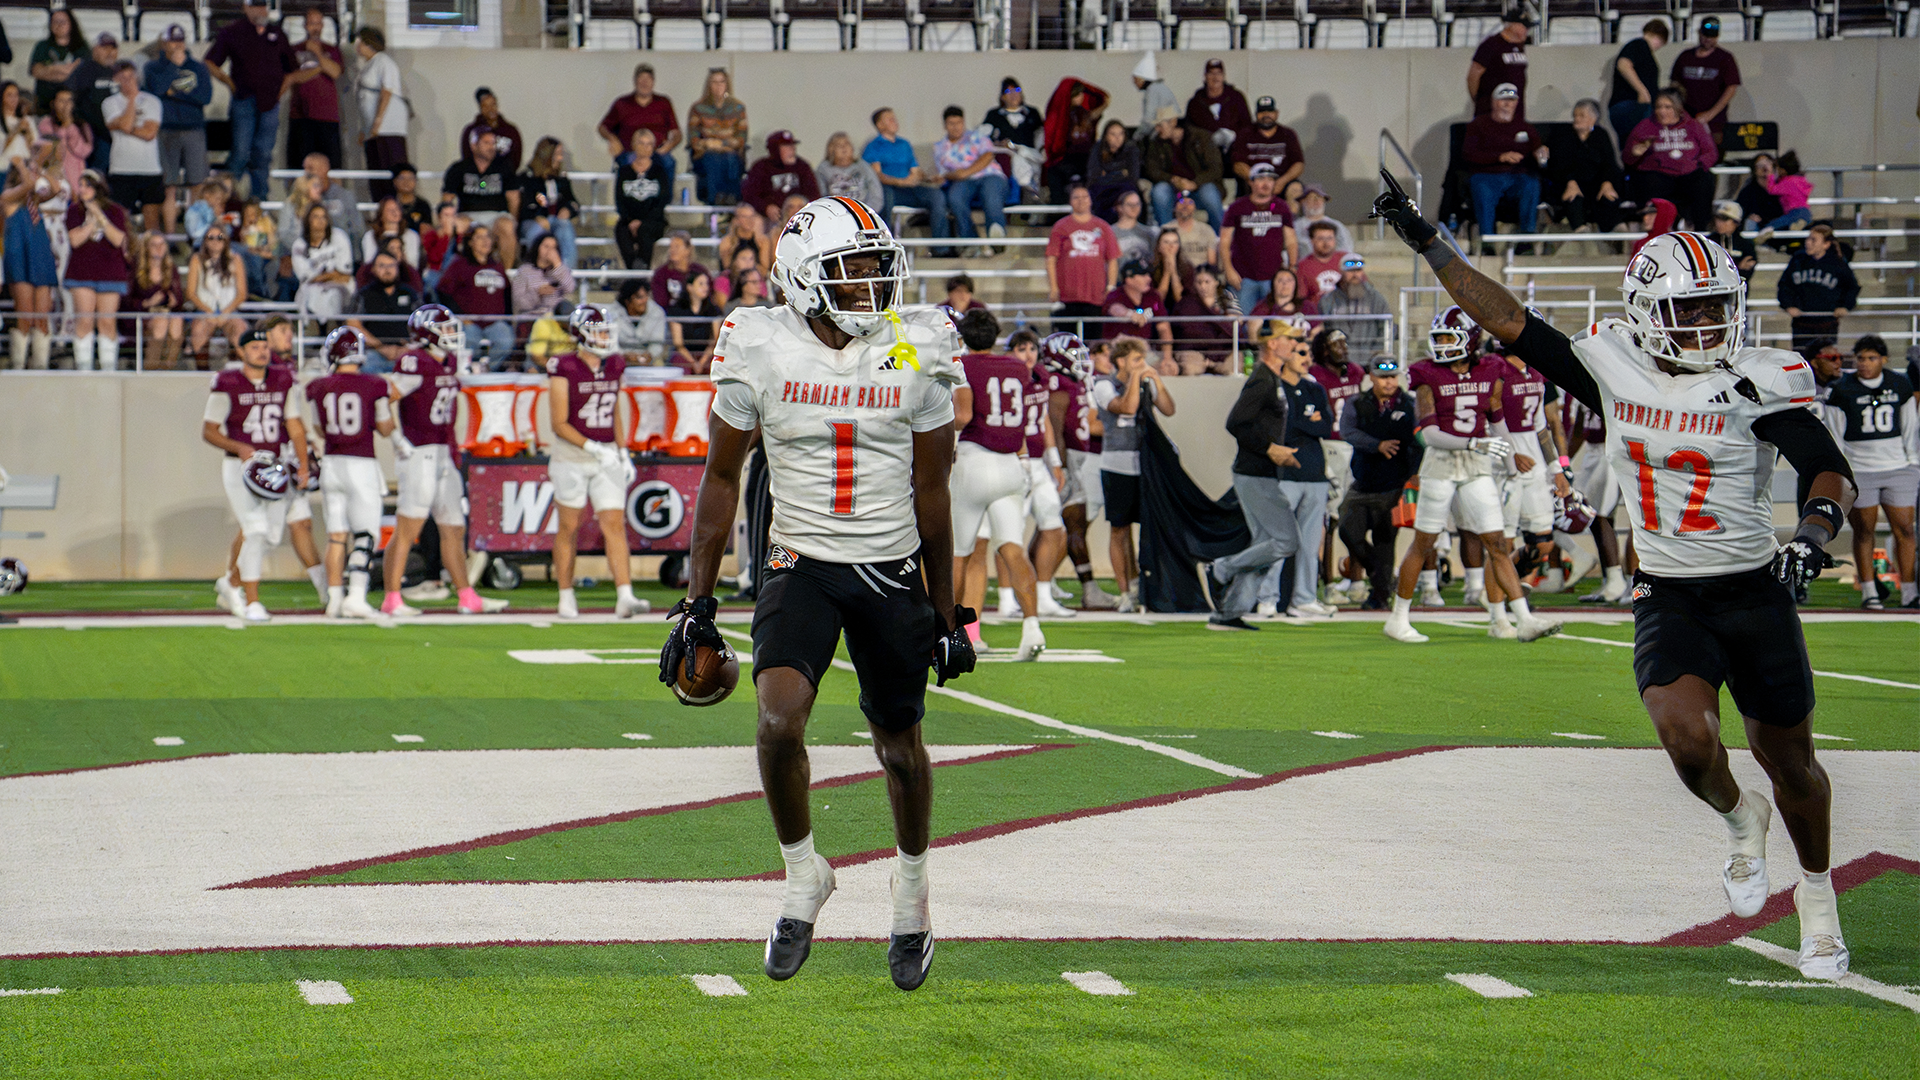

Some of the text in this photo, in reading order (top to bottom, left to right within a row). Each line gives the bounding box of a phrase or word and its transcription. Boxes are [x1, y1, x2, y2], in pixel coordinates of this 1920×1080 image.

[1792, 268, 1838, 291] DALLAS
[781, 380, 901, 408] PERMIAN BASIN
[986, 377, 1023, 427] 13
[1439, 384, 1457, 396] WEST
[1458, 382, 1477, 394] TEXAS
[243, 404, 283, 443] 46
[323, 392, 362, 436] 18
[578, 393, 617, 428] 42
[1453, 395, 1478, 433] 5
[1521, 396, 1539, 427] 7
[1613, 399, 1673, 431] PERMIAN
[1678, 412, 1725, 435] BASIN
[1861, 404, 1894, 433] 10
[824, 418, 858, 515] 1
[1621, 435, 1726, 537] 12
